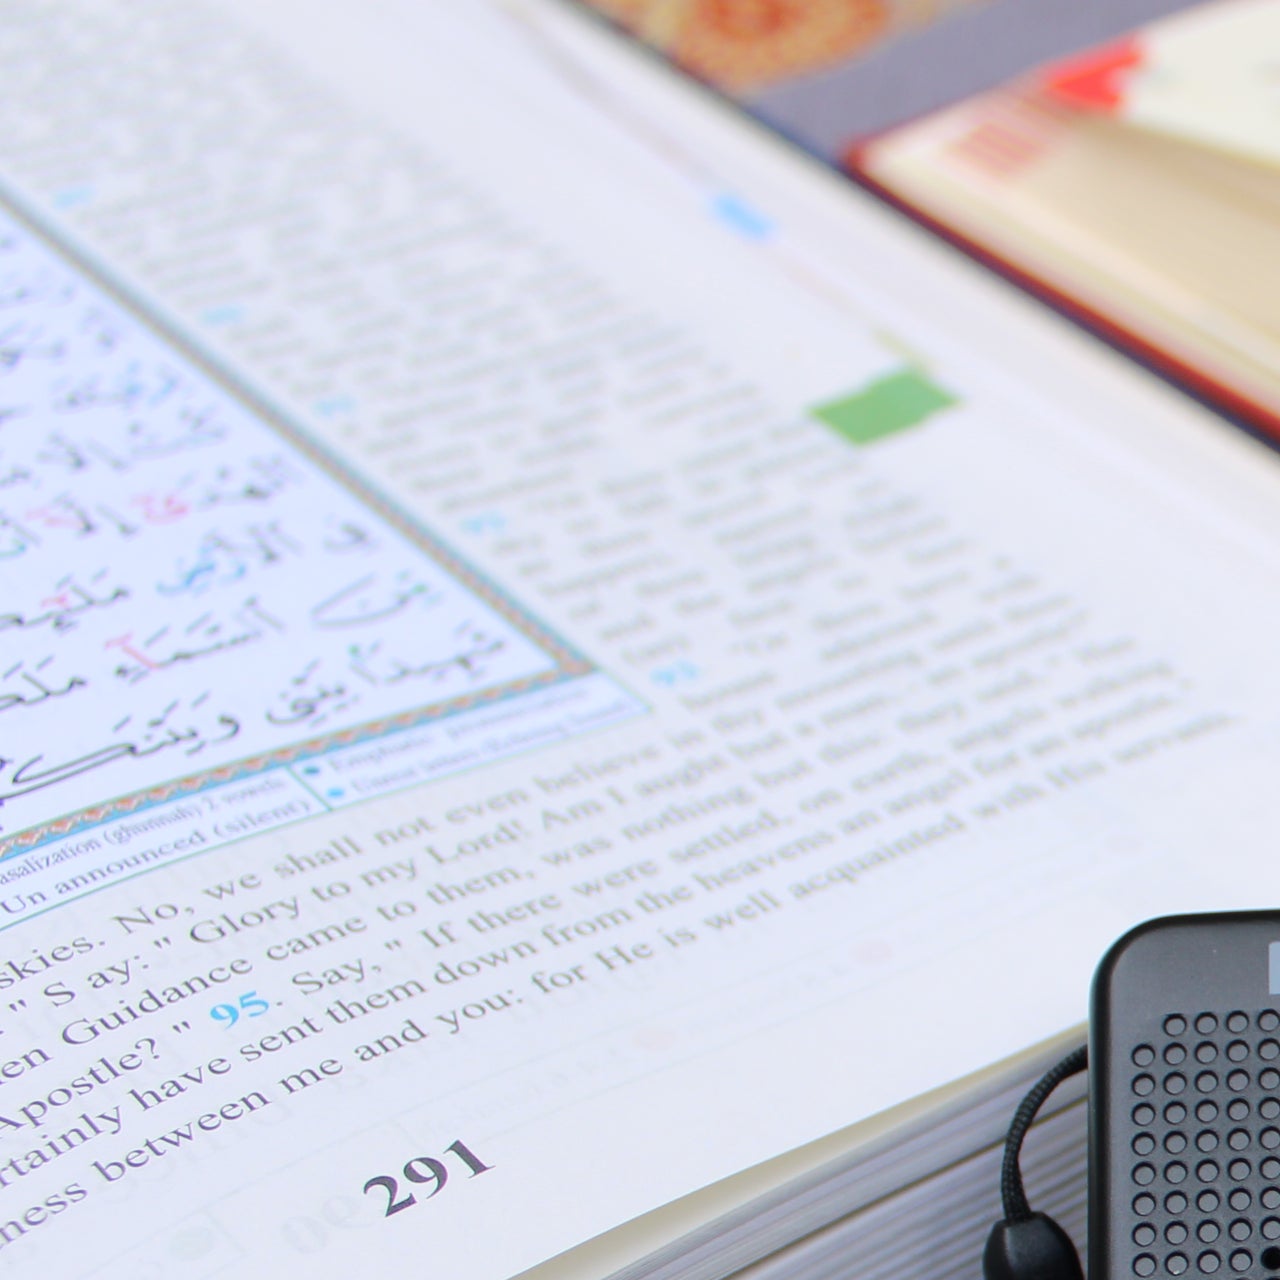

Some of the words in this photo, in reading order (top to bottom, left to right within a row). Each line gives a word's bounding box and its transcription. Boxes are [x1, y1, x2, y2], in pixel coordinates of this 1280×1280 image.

[0, 939, 105, 989] skies.
[111, 902, 195, 936] No,
[202, 872, 262, 900] we
[273, 835, 364, 879] shall
[374, 815, 438, 846] not
[444, 788, 531, 824] even
[0, 1048, 53, 1085] en
[62, 959, 252, 1046] Guidance
[266, 917, 368, 962] came
[377, 900, 417, 922] to
[425, 865, 536, 906] them,
[540, 835, 613, 868] was
[621, 785, 755, 842] nothing
[1, 891, 47, 915] Un
[55, 830, 207, 895] announced
[128, 1056, 233, 1111] have
[240, 1016, 324, 1062] sent
[325, 977, 428, 1024] them
[433, 938, 539, 985] down
[540, 905, 634, 946] from
[634, 883, 694, 914] the
[691, 830, 837, 892] heavens
[190, 897, 301, 944] Glory
[310, 880, 352, 902] to
[359, 858, 417, 889] my
[425, 818, 529, 865] Lord!
[540, 799, 605, 831] Am
[0, 1037, 160, 1132] Apostle?
[291, 959, 381, 996] Say,
[418, 922, 456, 948] If
[467, 893, 563, 933] there
[570, 860, 660, 897] were
[91, 1089, 273, 1183] between
[277, 1058, 343, 1094] me
[353, 1019, 428, 1062] and
[436, 989, 524, 1035] you:
[531, 964, 588, 995] for
[594, 942, 654, 971] He
[657, 927, 698, 949] is
[702, 888, 783, 931] well
[789, 812, 966, 900] acquainted
[362, 1139, 495, 1217] 291
